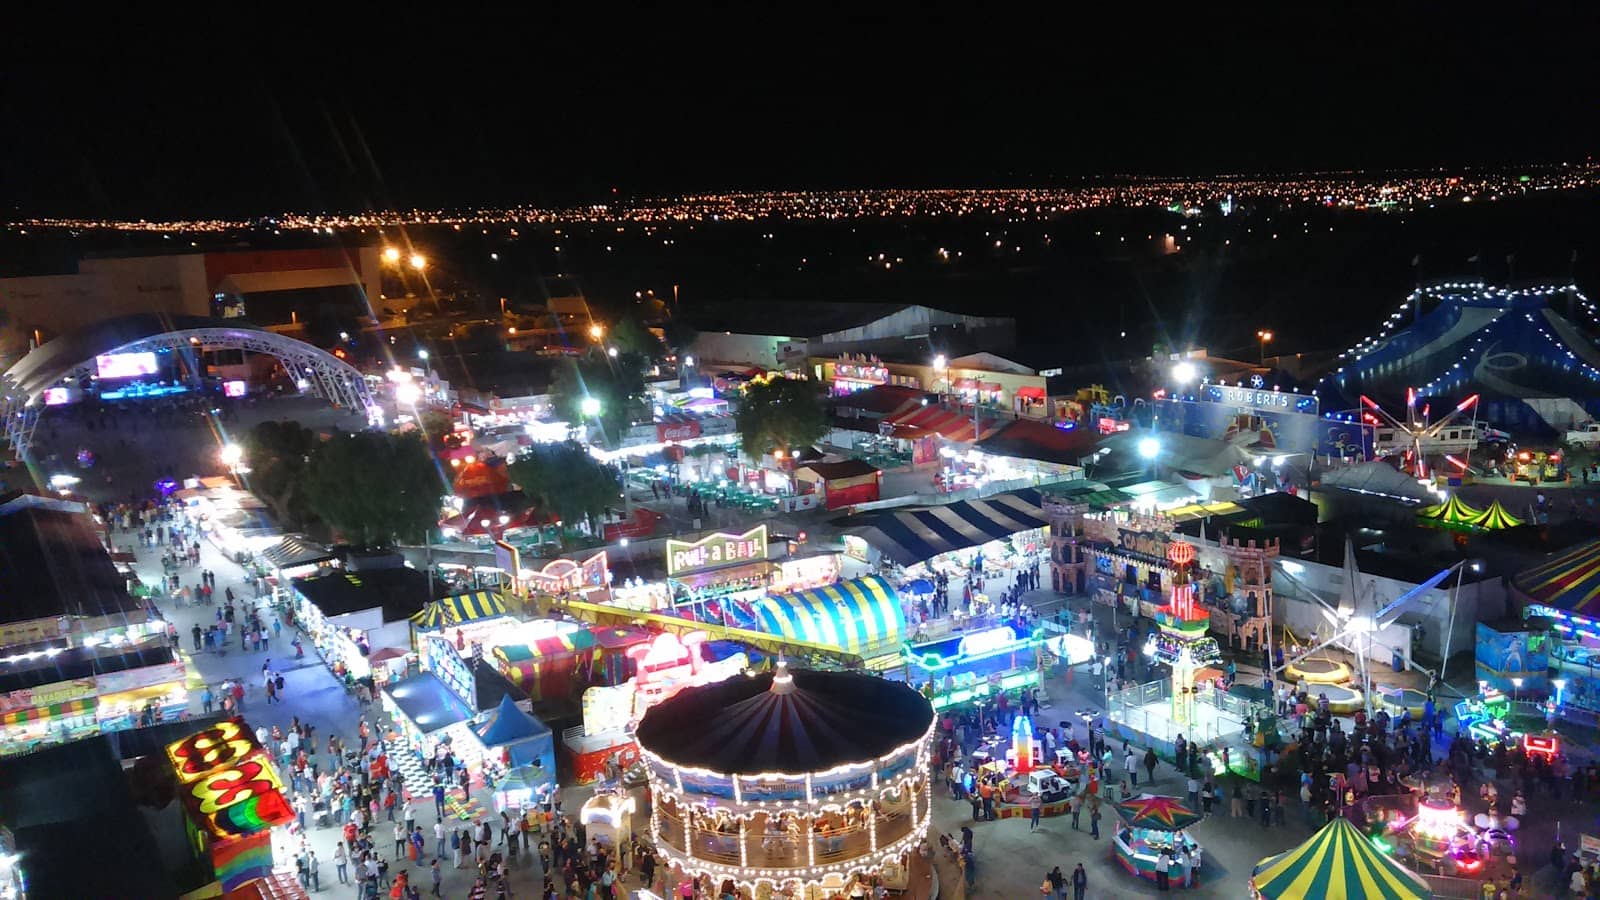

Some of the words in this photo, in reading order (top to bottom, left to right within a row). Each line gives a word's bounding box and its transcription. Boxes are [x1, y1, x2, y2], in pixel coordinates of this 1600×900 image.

[1228, 391, 1289, 407] ROBERT'S
[711, 545, 721, 561] a
[725, 537, 762, 561] BALL
